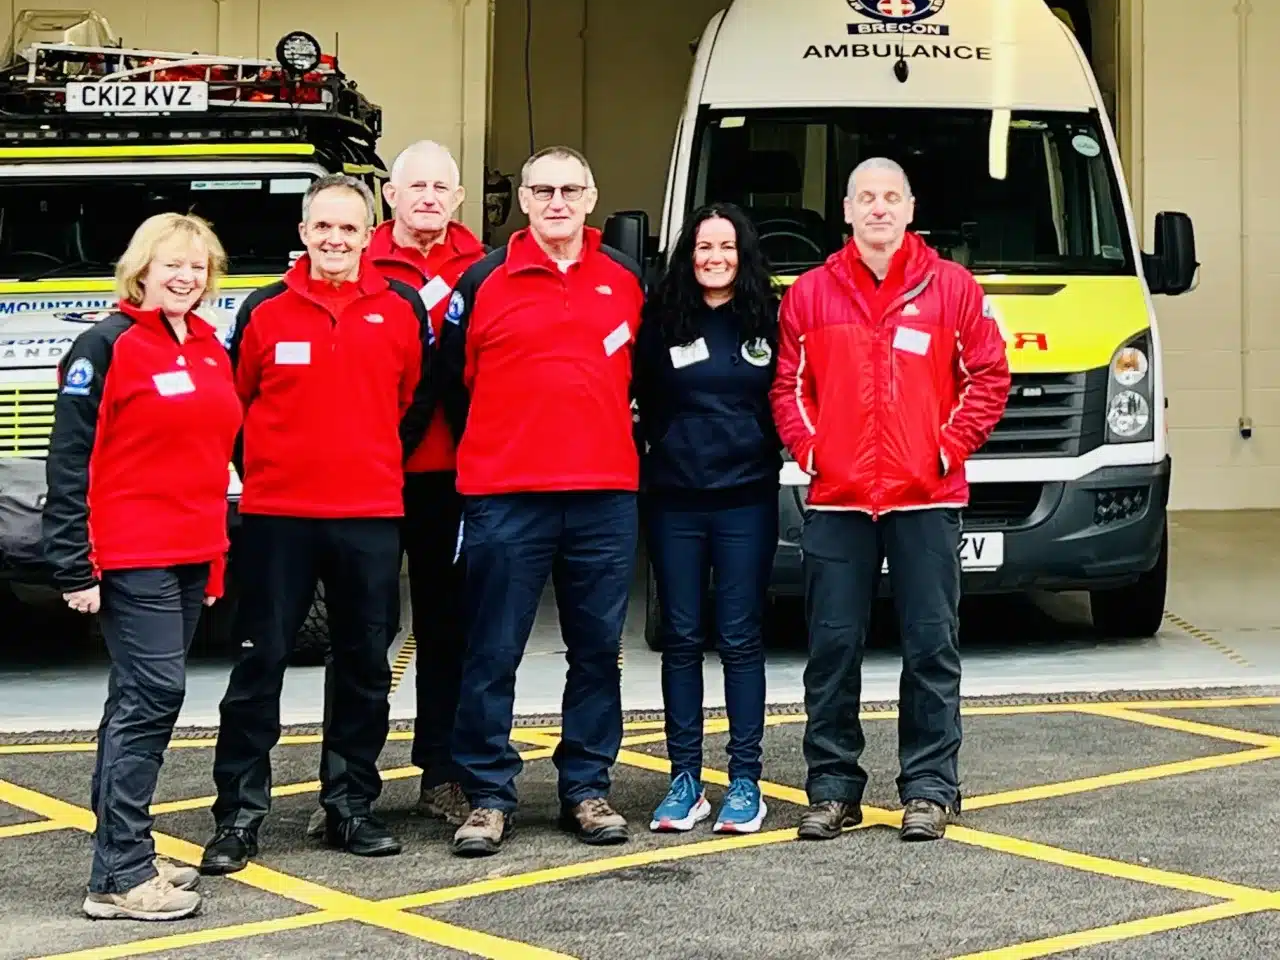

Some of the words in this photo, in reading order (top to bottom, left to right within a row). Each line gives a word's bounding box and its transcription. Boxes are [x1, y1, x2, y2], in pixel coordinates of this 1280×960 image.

[857, 22, 941, 35] BRECON
[803, 43, 992, 60] AMBULANCE
[82, 85, 136, 106] CK12
[144, 85, 192, 106] KVZ
[0, 299, 107, 315] MOUNTAIN
[3, 347, 63, 358] AND
[960, 537, 986, 560] ZV
